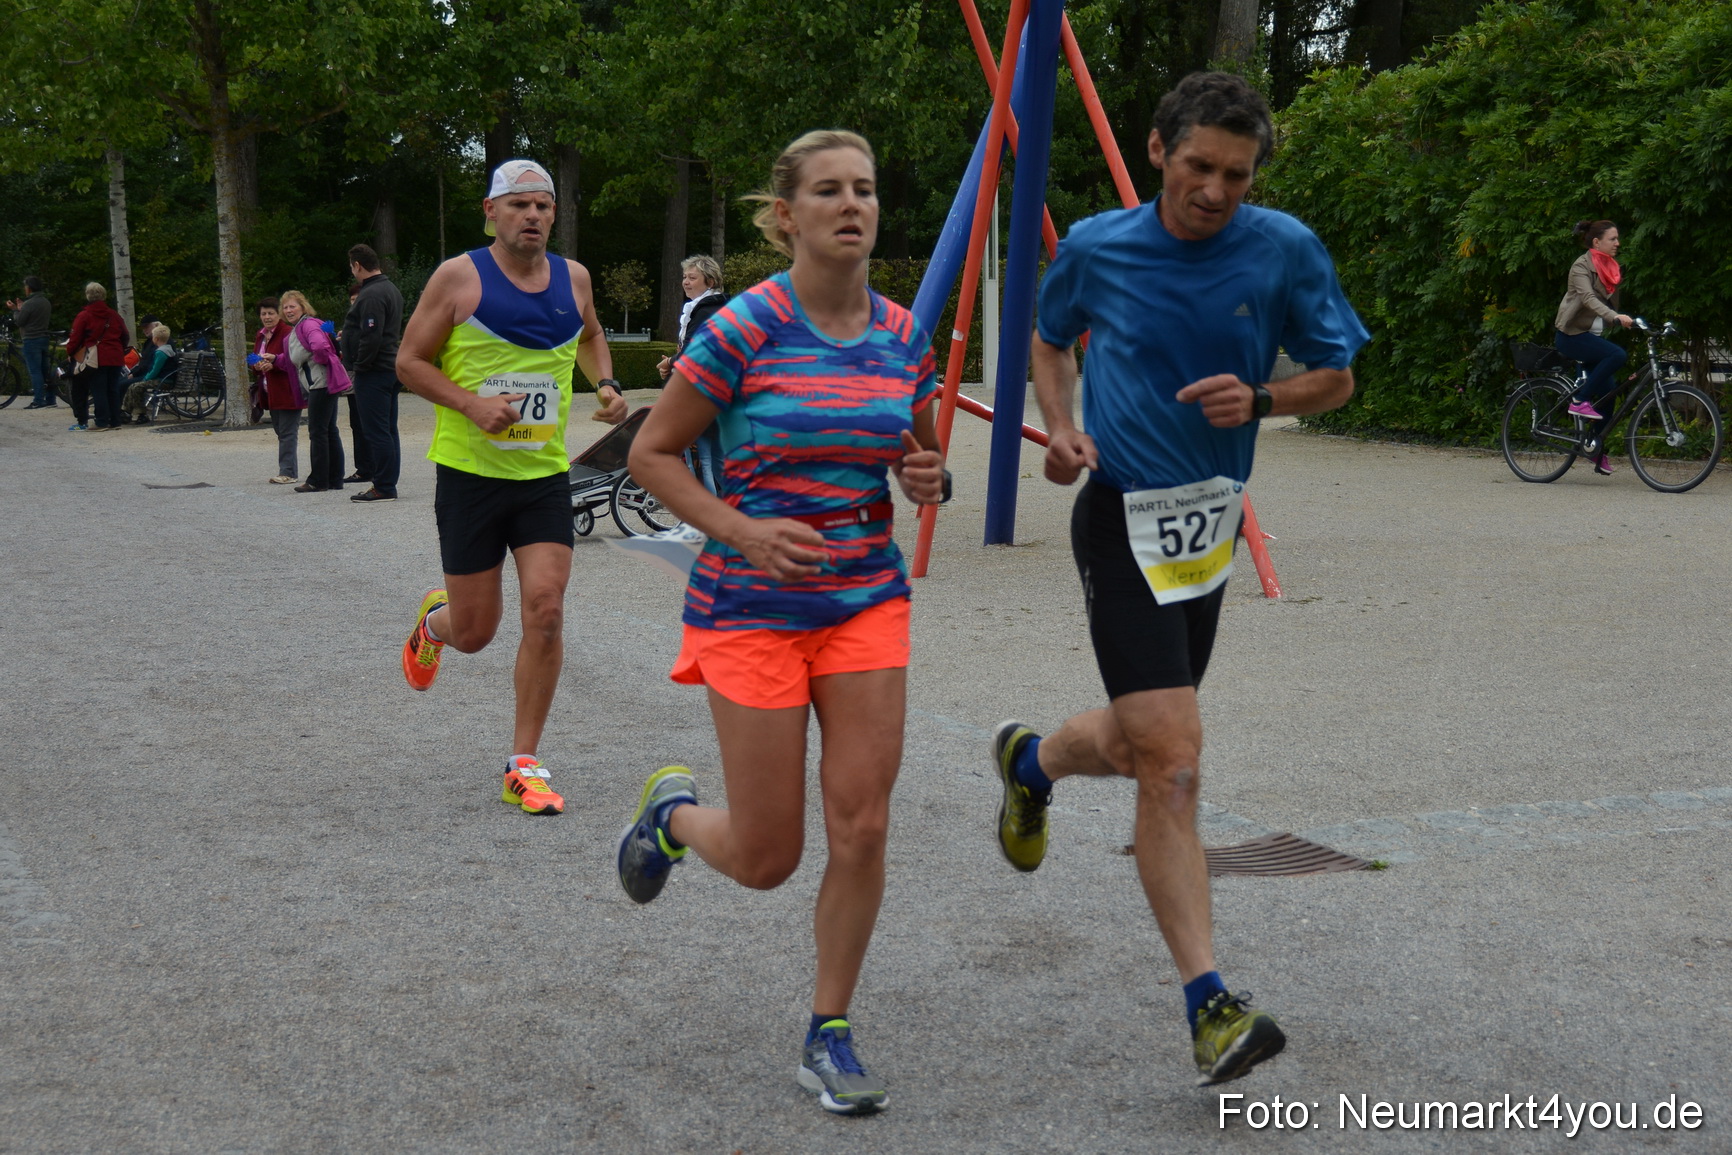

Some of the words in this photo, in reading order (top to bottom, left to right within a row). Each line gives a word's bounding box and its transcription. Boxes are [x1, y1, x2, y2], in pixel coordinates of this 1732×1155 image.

[499, 392, 547, 421] 78
[508, 428, 532, 439] Andi
[1129, 499, 1172, 514] PARTL
[1175, 487, 1231, 508] Neumarkt
[1156, 504, 1227, 558] 527
